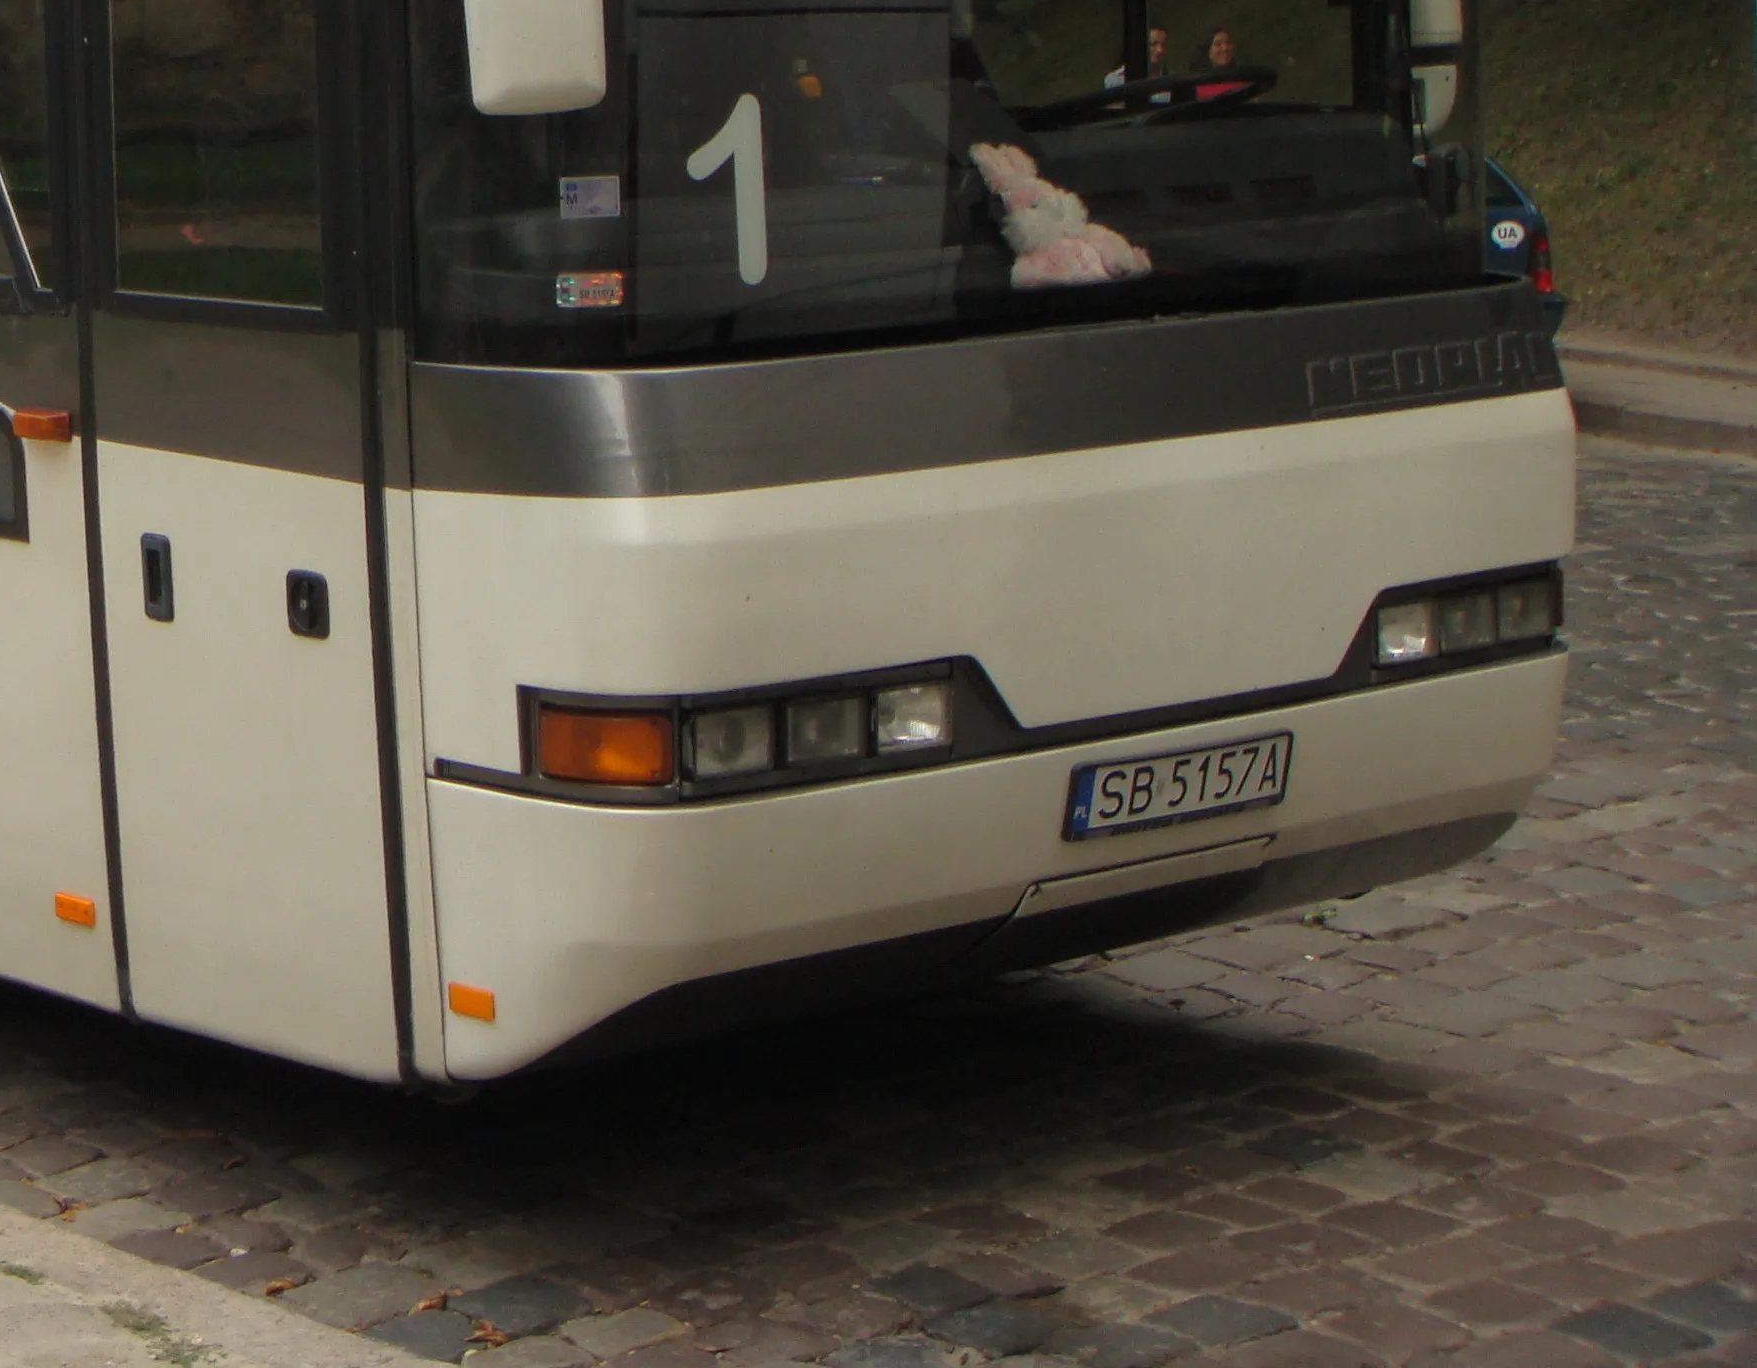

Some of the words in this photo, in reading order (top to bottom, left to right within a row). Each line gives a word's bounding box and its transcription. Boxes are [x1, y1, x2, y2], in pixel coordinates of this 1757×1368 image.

[686, 93, 768, 287] 1
[1497, 226, 1518, 240] UA
[1098, 766, 1154, 819] SB
[1168, 743, 1277, 807] 5157A
[1074, 805, 1088, 820] PL
